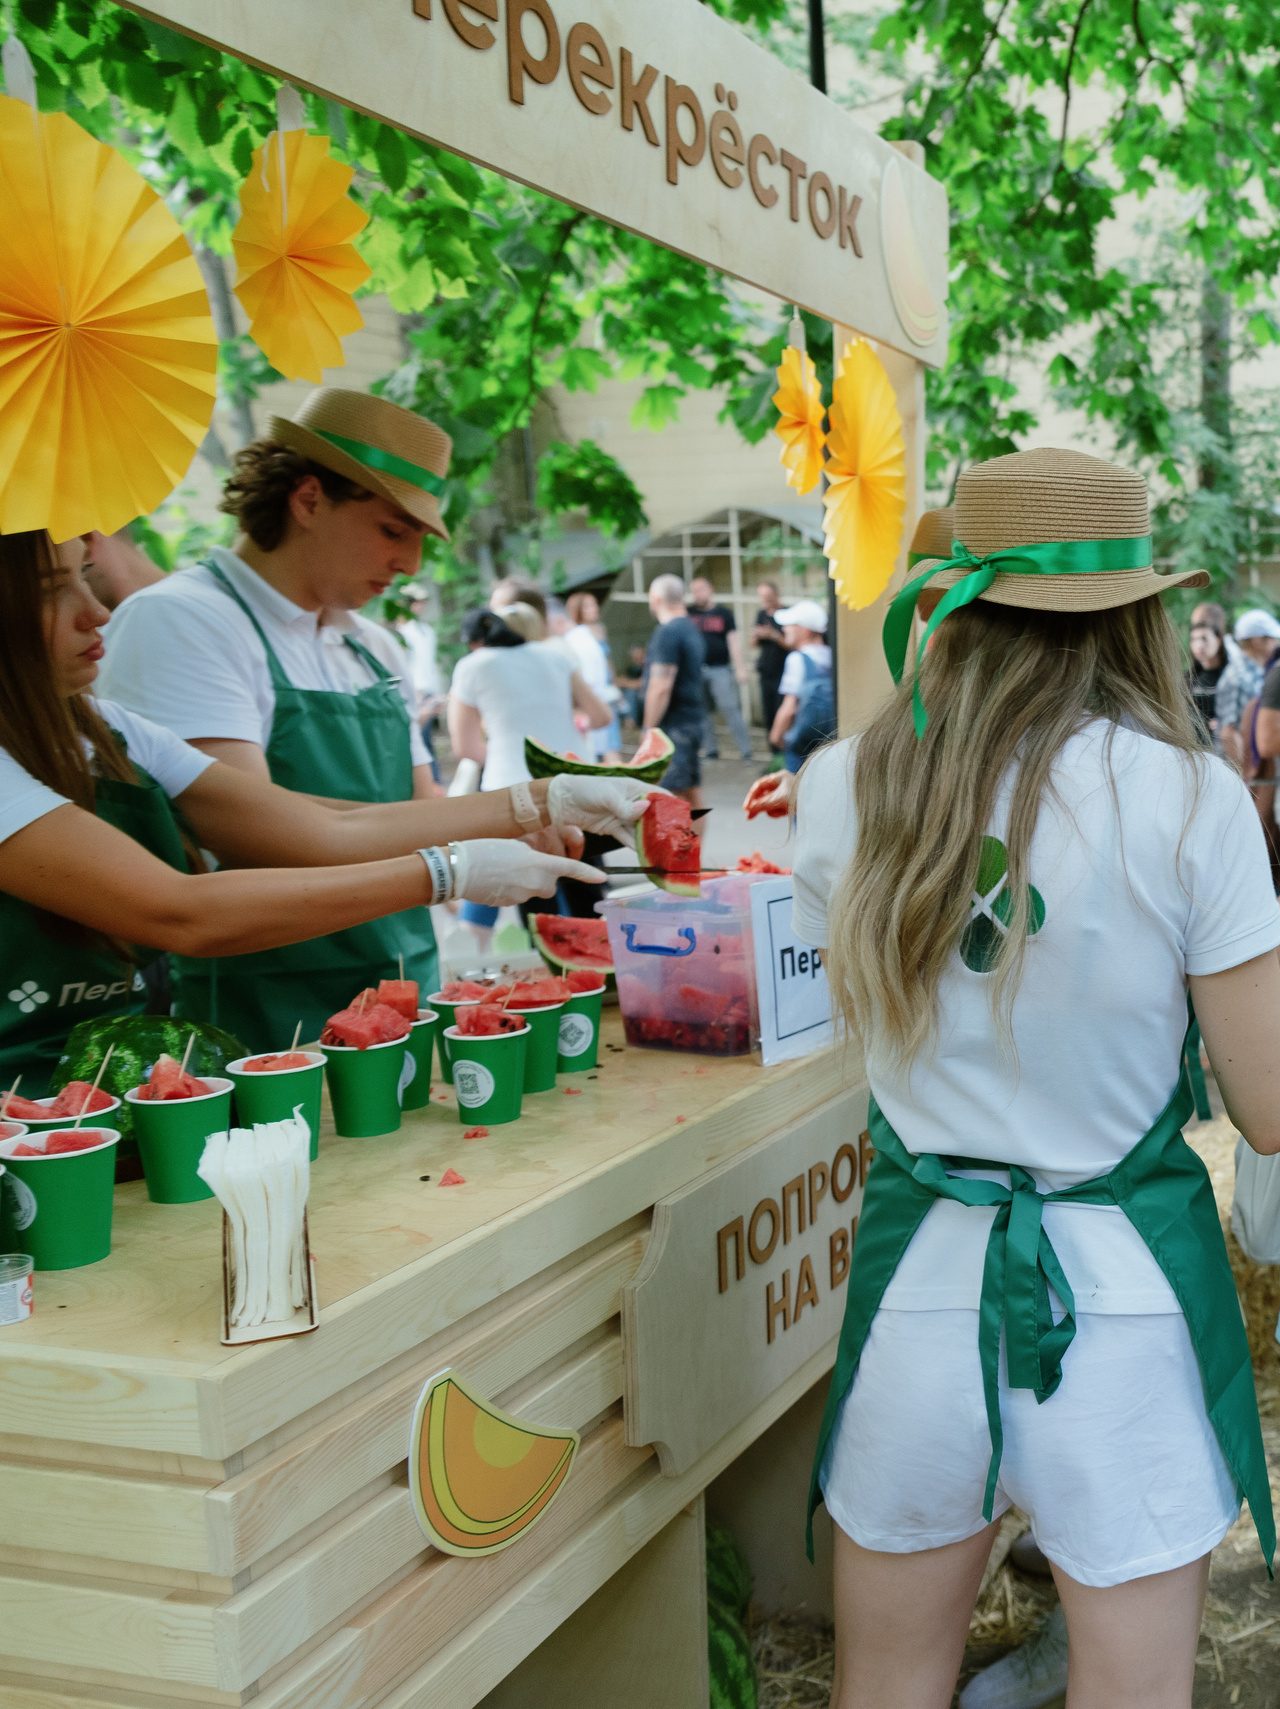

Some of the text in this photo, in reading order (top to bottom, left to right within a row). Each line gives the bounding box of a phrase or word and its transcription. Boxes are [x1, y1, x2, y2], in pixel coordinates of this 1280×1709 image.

[411, 0, 864, 259] ерекрёсток
[780, 946, 822, 980] Пер
[766, 1215, 858, 1346] НА В
